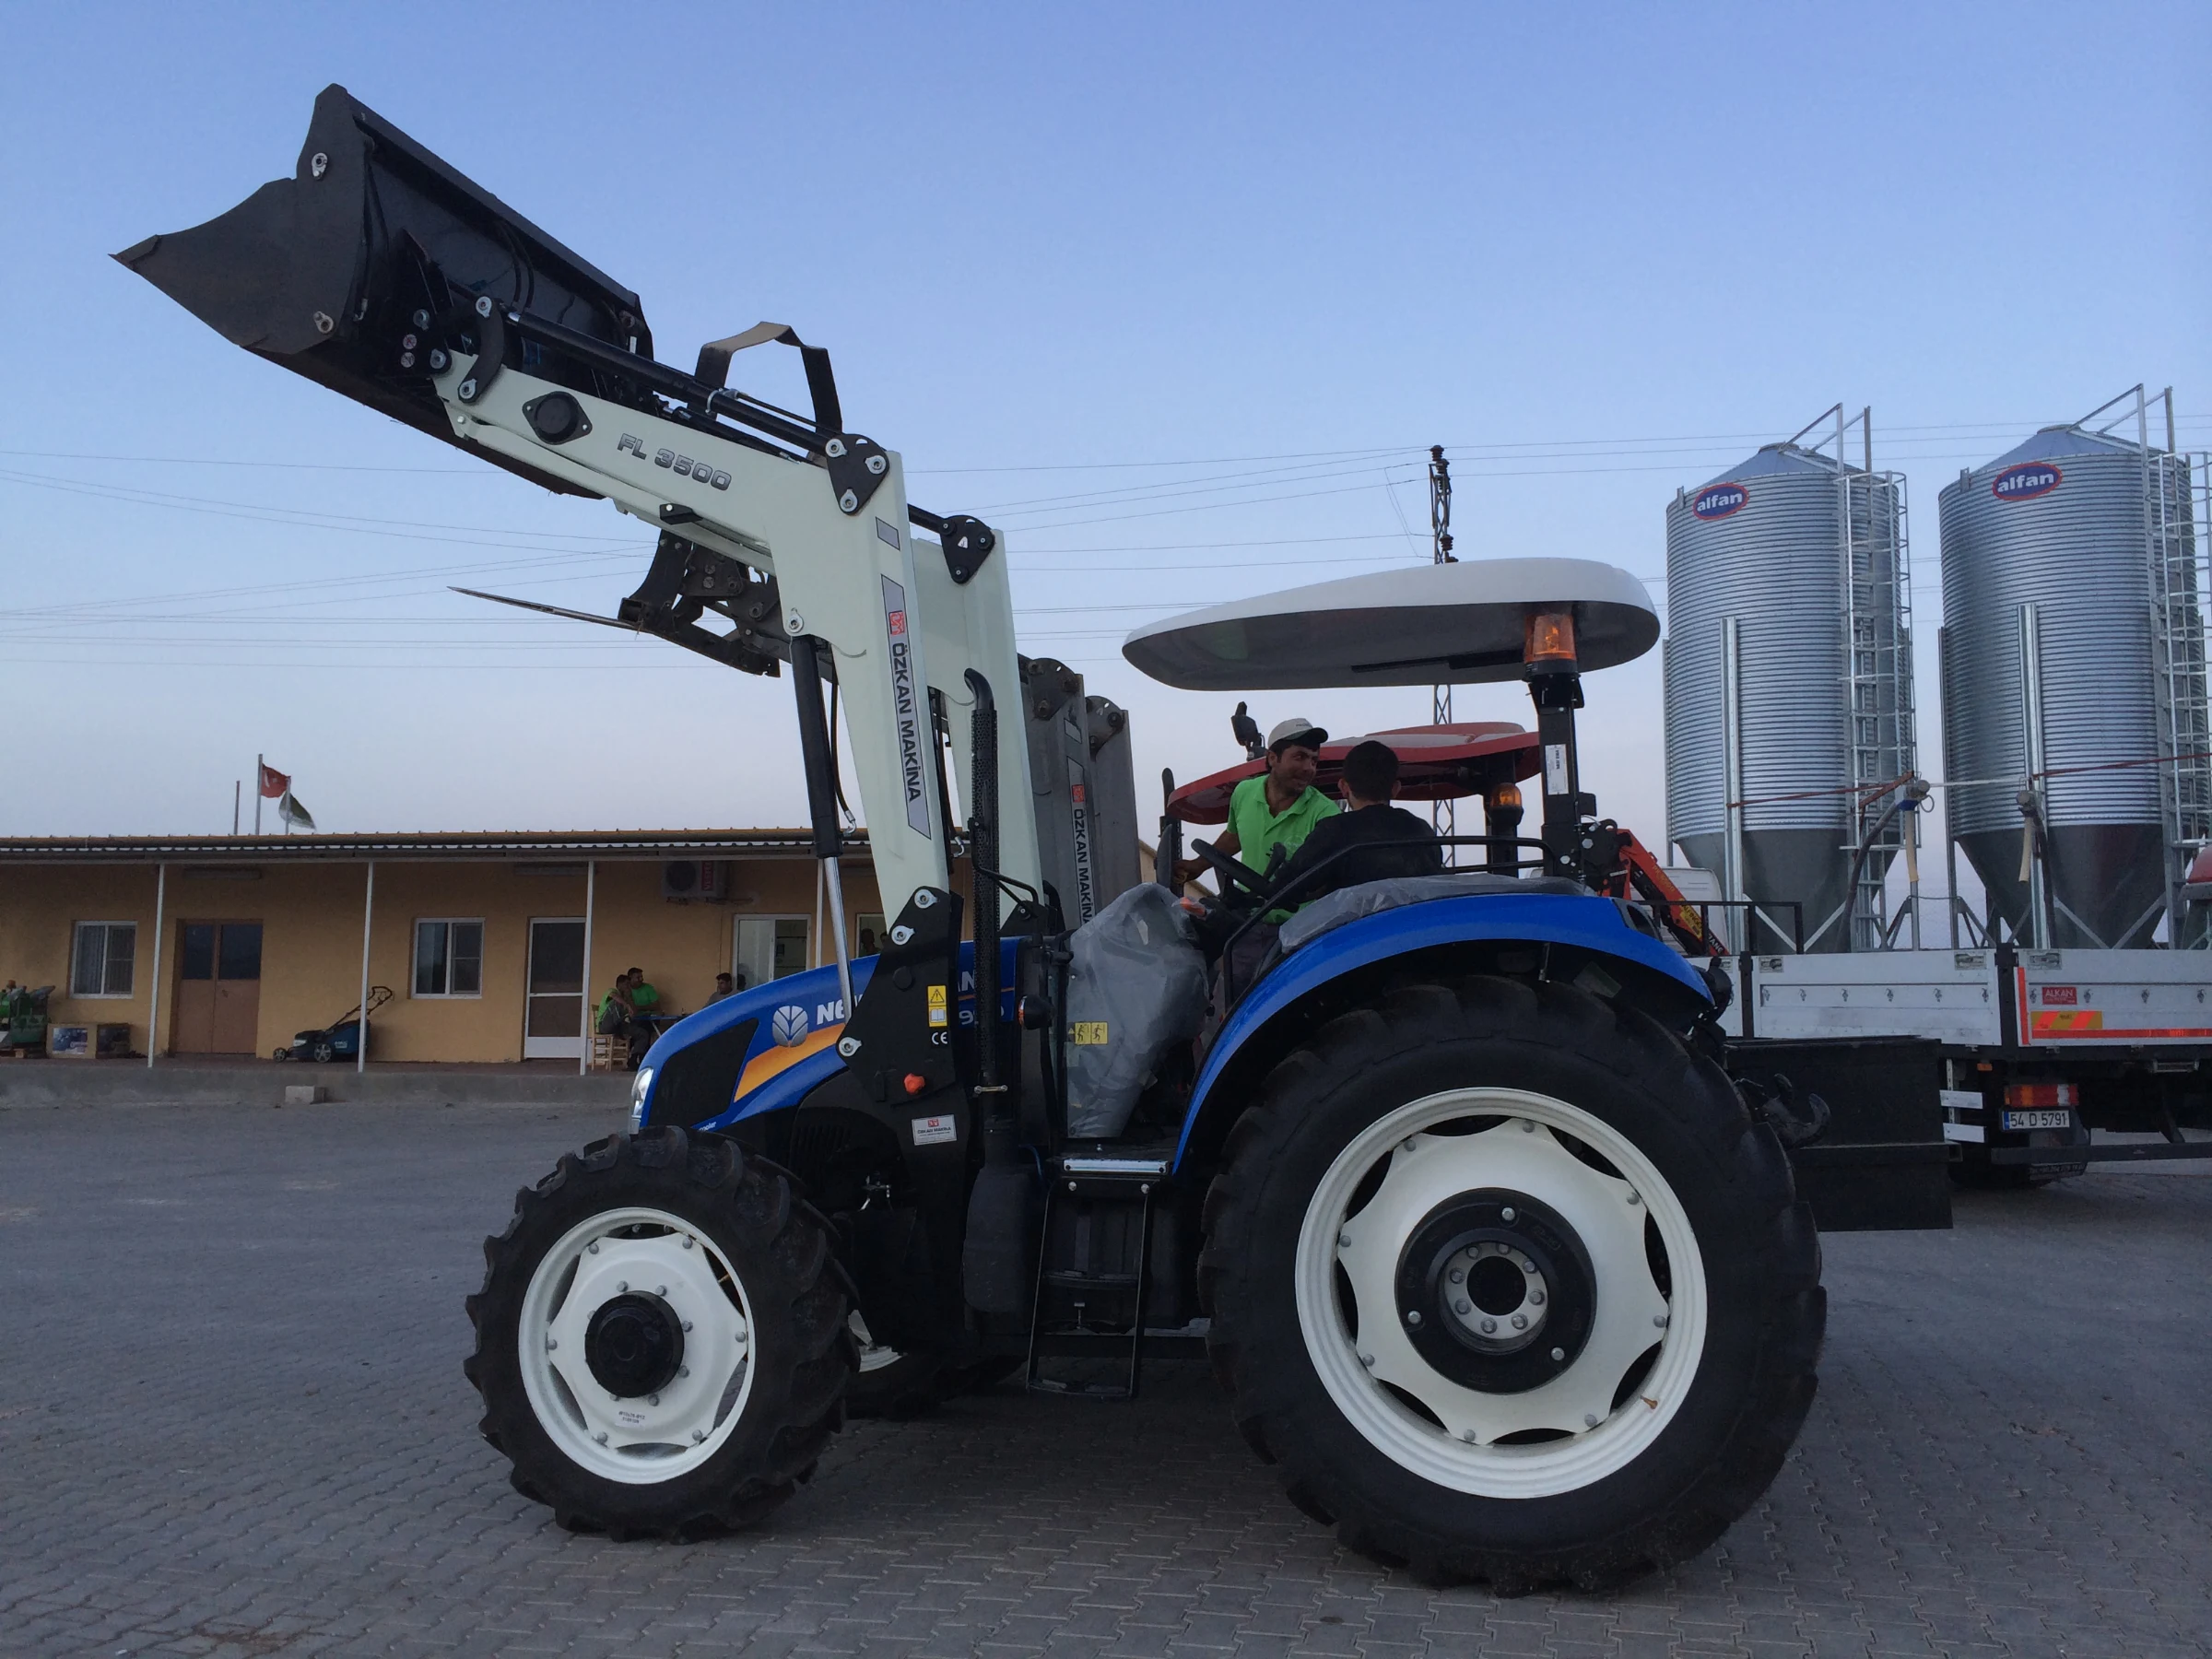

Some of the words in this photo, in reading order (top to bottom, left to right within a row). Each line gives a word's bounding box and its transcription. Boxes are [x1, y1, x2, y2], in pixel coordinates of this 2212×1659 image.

[617, 432, 647, 461] FL
[653, 448, 733, 491] 3500
[1997, 473, 2054, 493] alfan
[1697, 492, 1743, 512] alfan
[892, 642, 912, 714] ÖZKAN
[900, 719, 922, 803] MAKİNA
[1074, 808, 1088, 863] ÖZKAN
[2045, 988, 2074, 997] ALKAN
[931, 1031, 948, 1045] CE
[2010, 1112, 2025, 1127] 54
[2029, 1112, 2038, 1126] D
[2041, 1112, 2067, 1126] 5791
